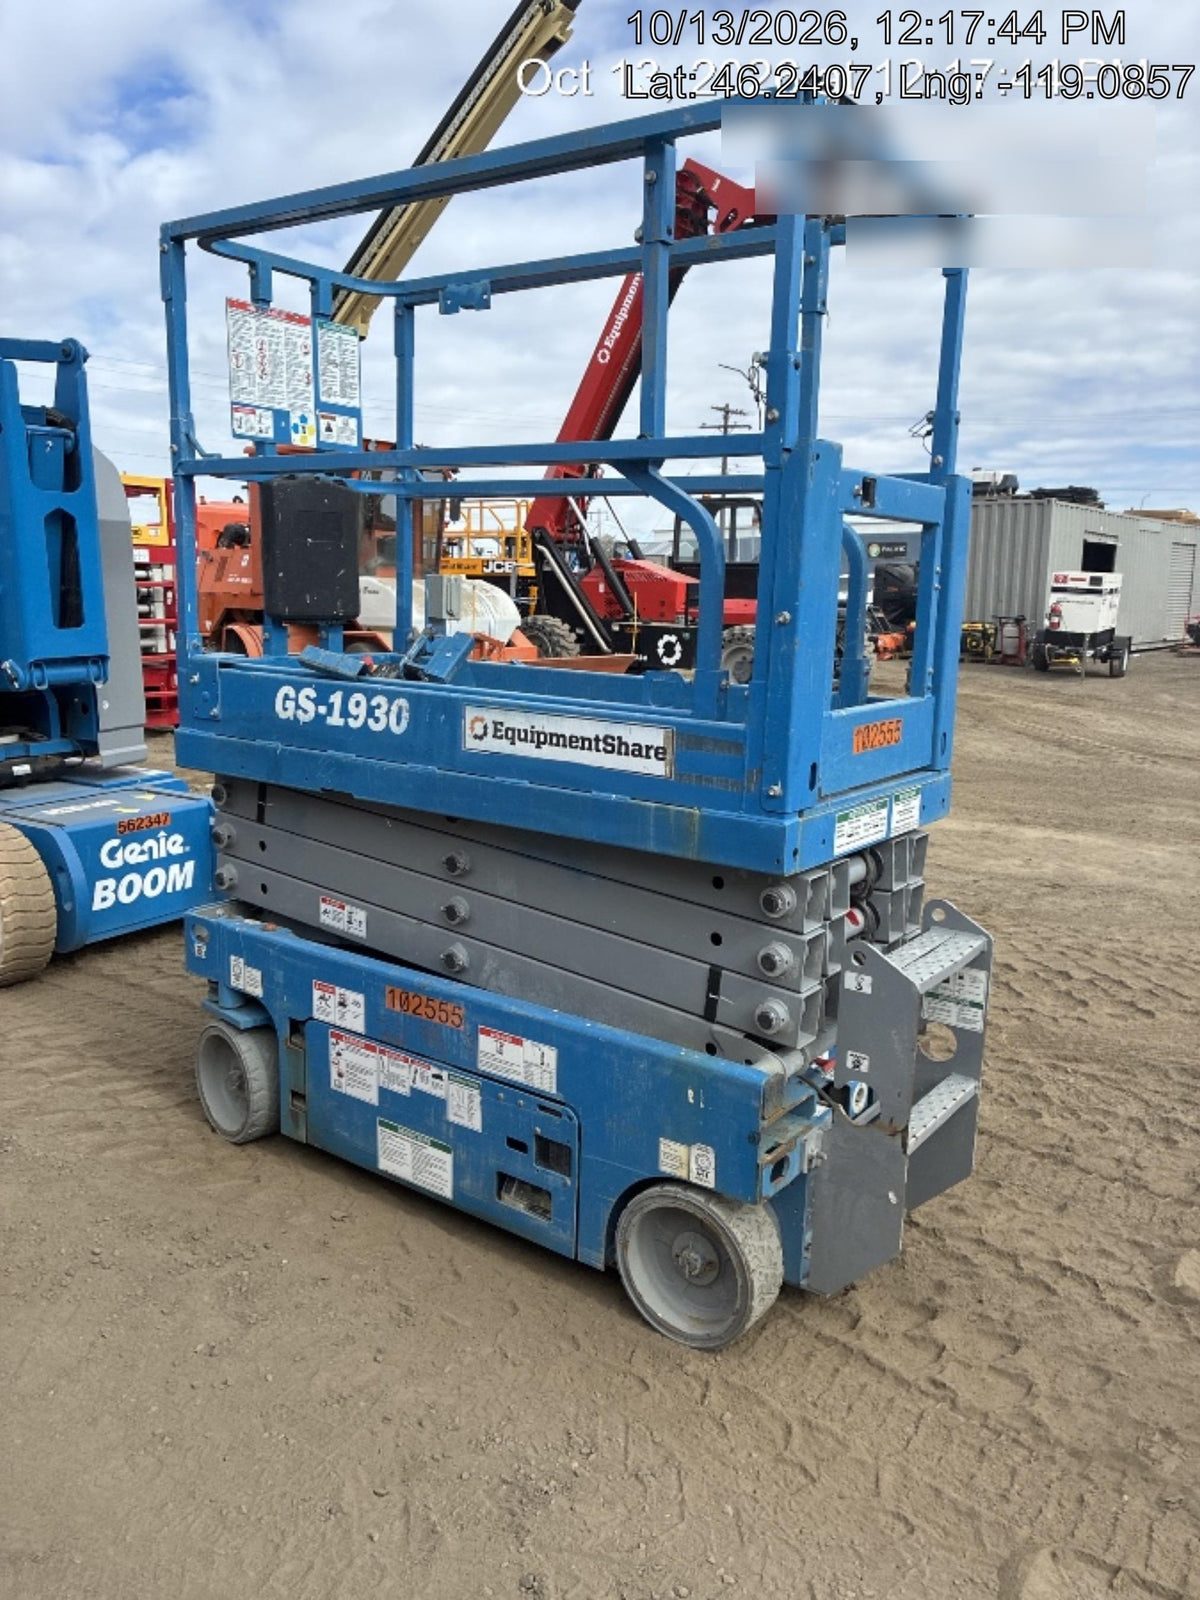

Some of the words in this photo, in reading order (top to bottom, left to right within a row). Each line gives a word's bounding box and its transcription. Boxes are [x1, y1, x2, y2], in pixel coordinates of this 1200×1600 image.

[275, 685, 410, 735] GS-1930
[492, 719, 668, 762] EquipmentShare
[855, 719, 903, 753] 102555
[118, 812, 170, 835] 562347
[92, 860, 196, 911] BOOM
[388, 988, 463, 1028] 102555
